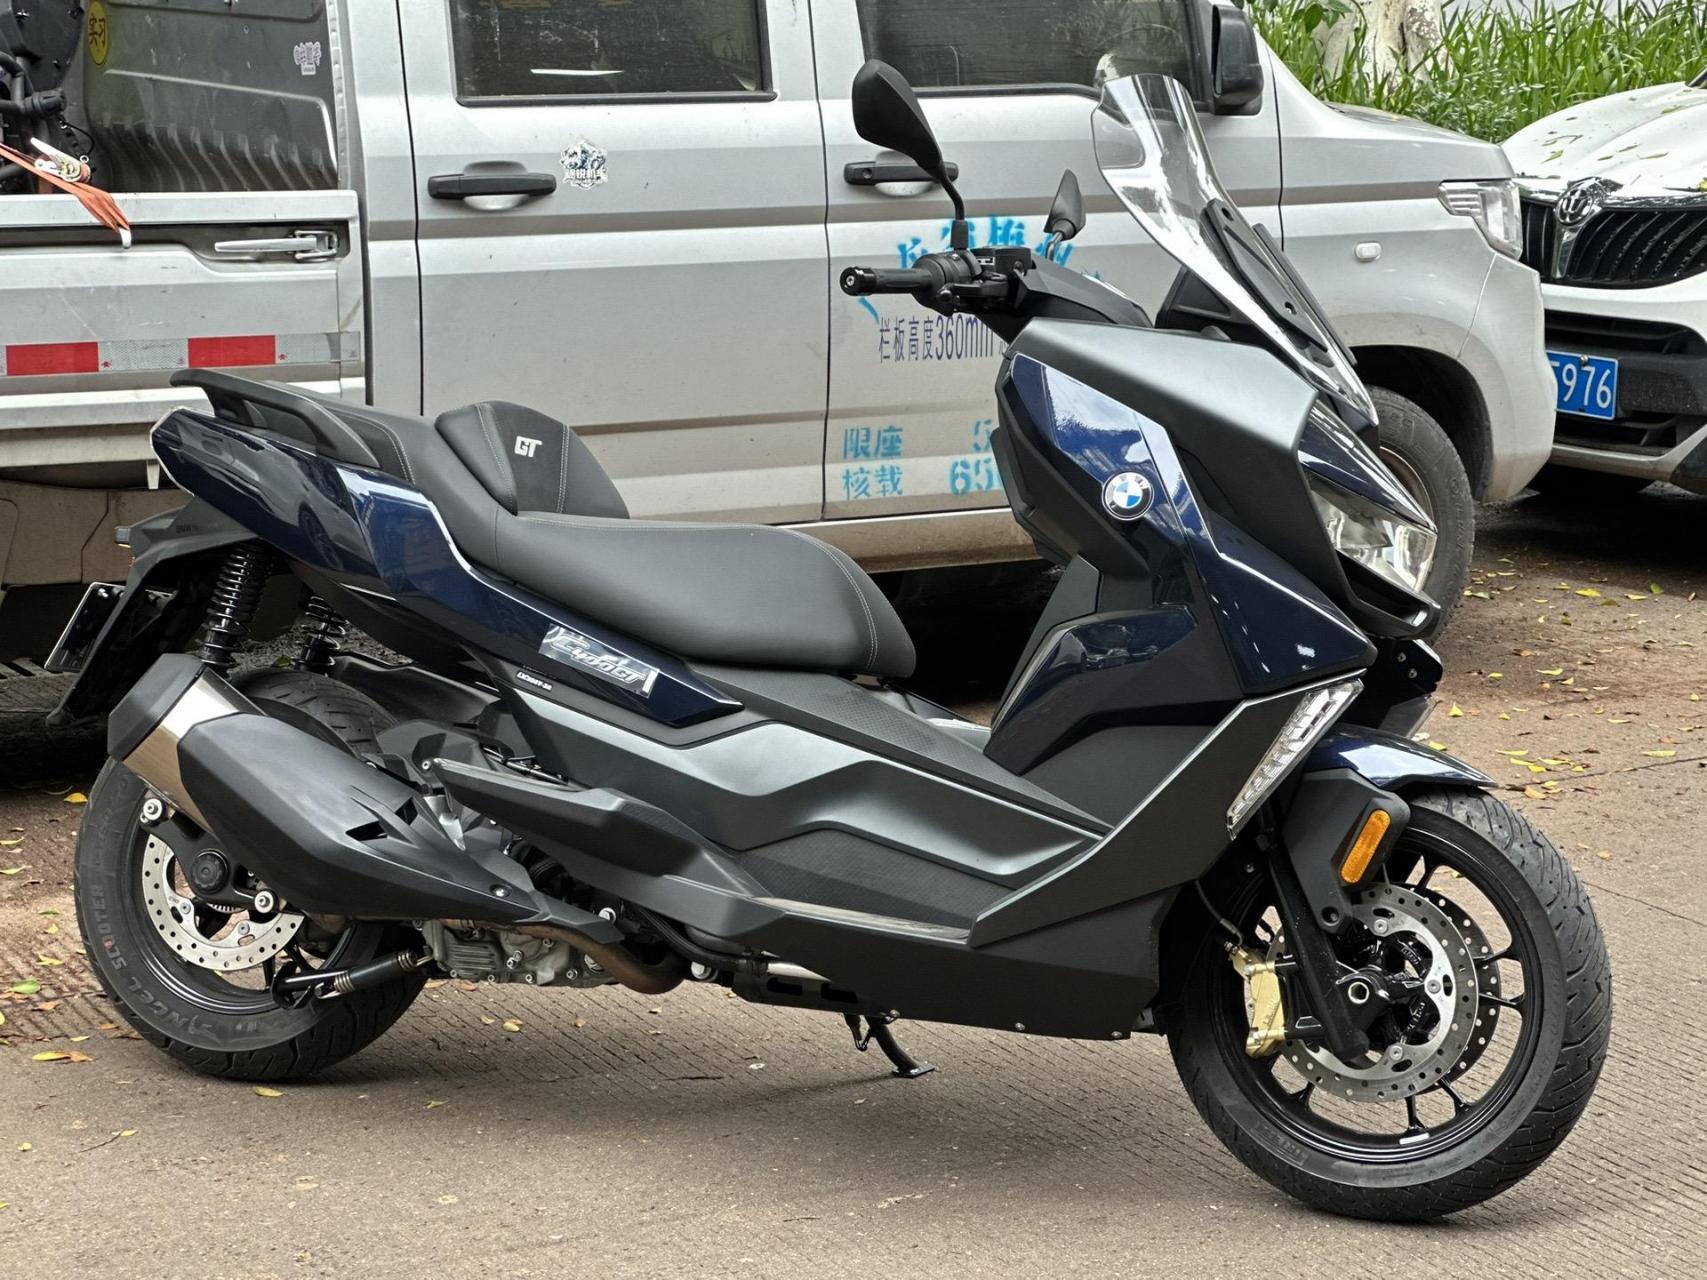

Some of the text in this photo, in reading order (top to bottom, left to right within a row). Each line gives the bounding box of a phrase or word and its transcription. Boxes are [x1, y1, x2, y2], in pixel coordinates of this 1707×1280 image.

[88, 13, 106, 48] 实习
[1550, 361, 1612, 409] 976
[514, 435, 543, 458] GT
[843, 425, 904, 460] 限座
[842, 464, 904, 500] 核载
[549, 634, 646, 685] C400GT
